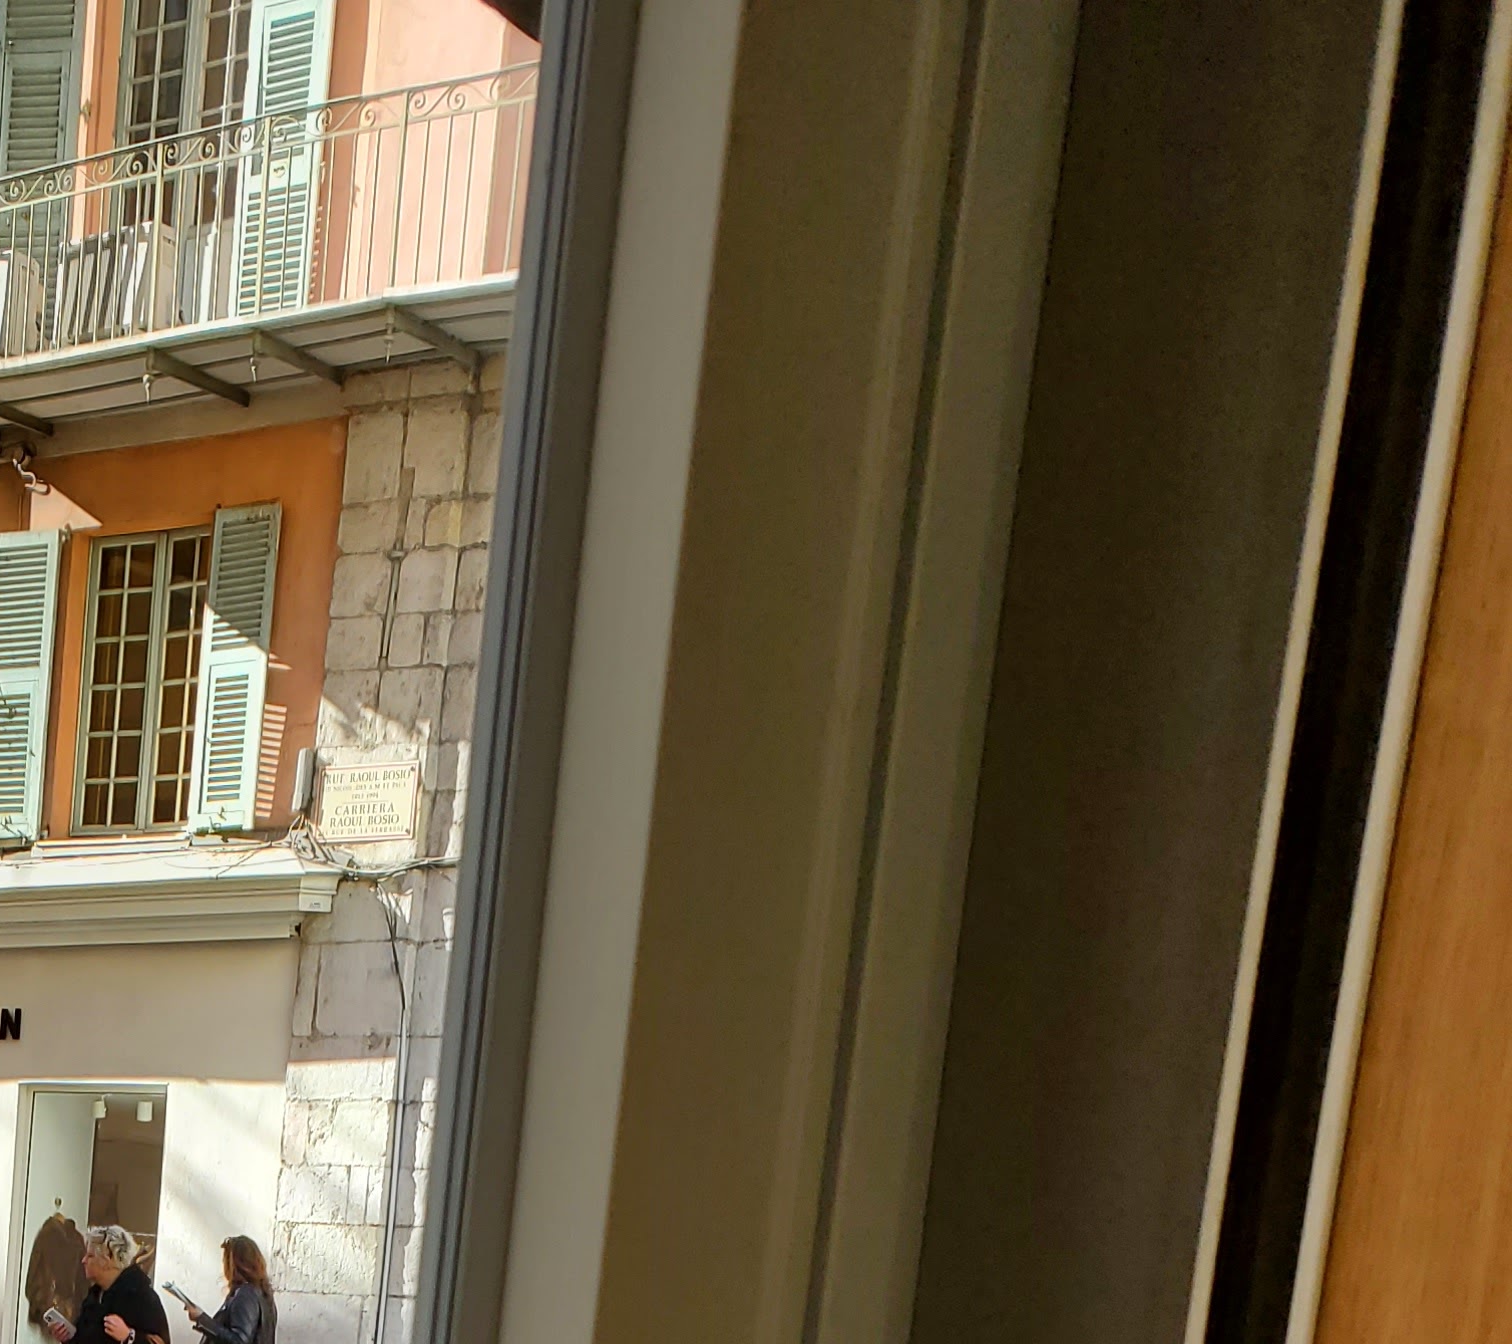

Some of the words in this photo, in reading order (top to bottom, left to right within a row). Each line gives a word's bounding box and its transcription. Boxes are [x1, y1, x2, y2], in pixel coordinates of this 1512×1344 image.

[350, 771, 379, 782] RAOUL
[383, 769, 411, 780] BOSIO
[334, 802, 394, 815] CARRIERA
[330, 816, 362, 828] RAOUL
[368, 814, 399, 826] BOSIO
